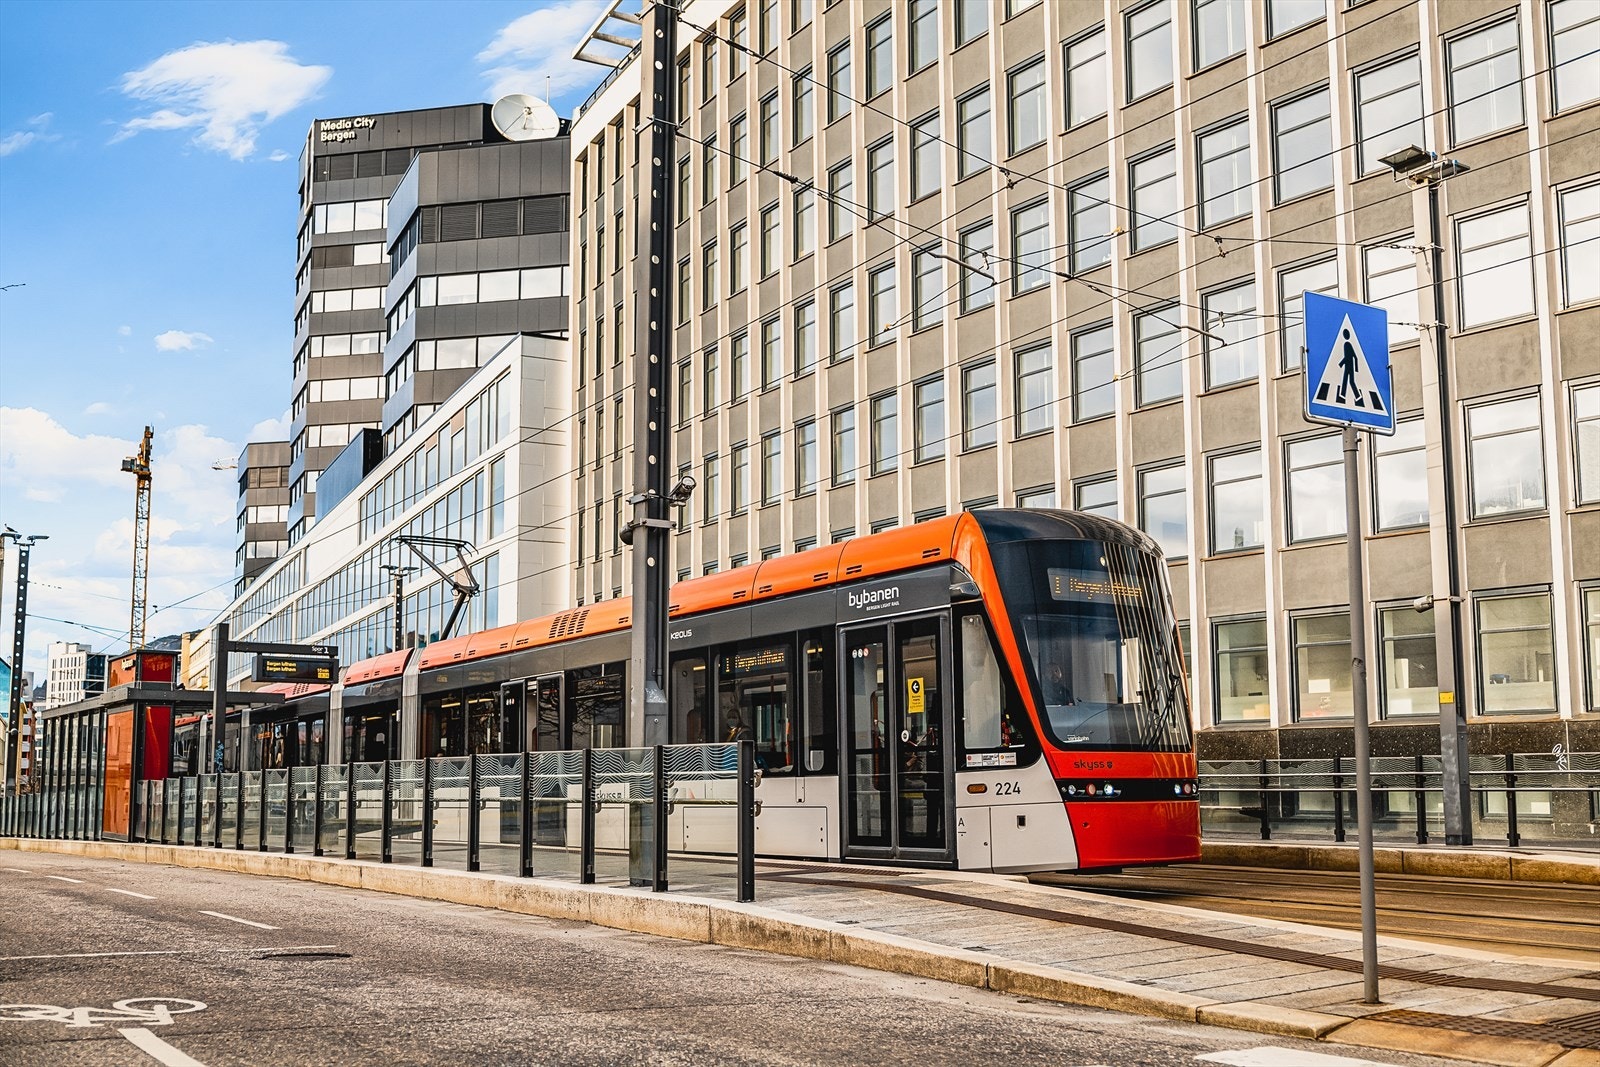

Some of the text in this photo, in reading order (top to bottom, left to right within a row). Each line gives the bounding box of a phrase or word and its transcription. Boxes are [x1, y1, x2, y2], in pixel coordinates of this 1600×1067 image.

[321, 117, 375, 131] Media City
[321, 131, 355, 142] Bergen
[848, 586, 899, 609] bybanen
[1074, 759, 1105, 770] skyss
[995, 781, 1021, 796] 224
[958, 817, 965, 827] A
